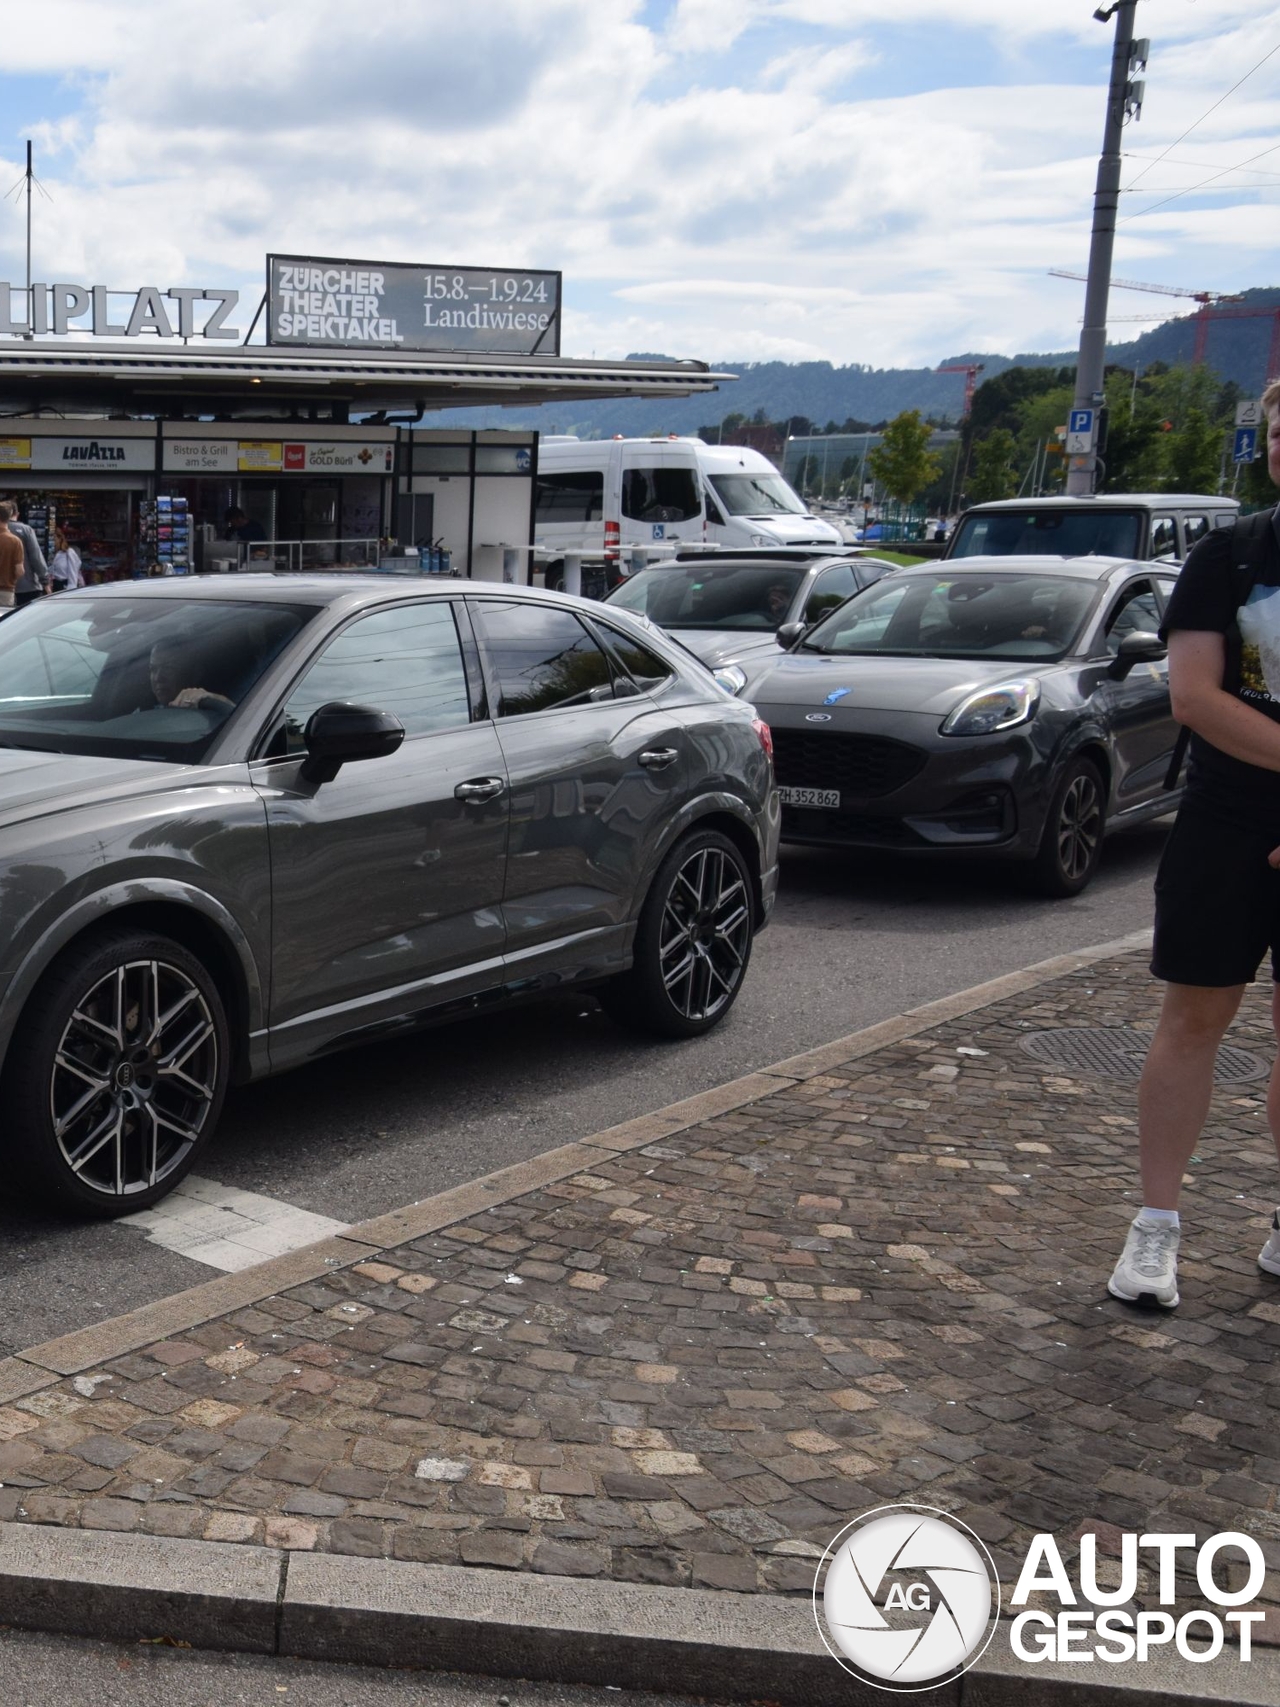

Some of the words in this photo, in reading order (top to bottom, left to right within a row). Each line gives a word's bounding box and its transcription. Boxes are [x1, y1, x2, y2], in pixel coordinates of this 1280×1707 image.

[278, 265, 385, 296] ZÜRCHER
[279, 290, 380, 318] THEATER
[423, 303, 549, 332] Landiwiese
[278, 313, 404, 343] SPEKTAKEL
[1075, 413, 1087, 430] P
[62, 441, 126, 461] LAVAZZA
[173, 445, 199, 455] Bistro
[201, 445, 208, 455] &
[210, 445, 228, 456] Grill
[185, 459, 200, 467] am
[201, 457, 218, 467] See
[309, 456, 333, 465] GOLD
[817, 791, 838, 806] 862
